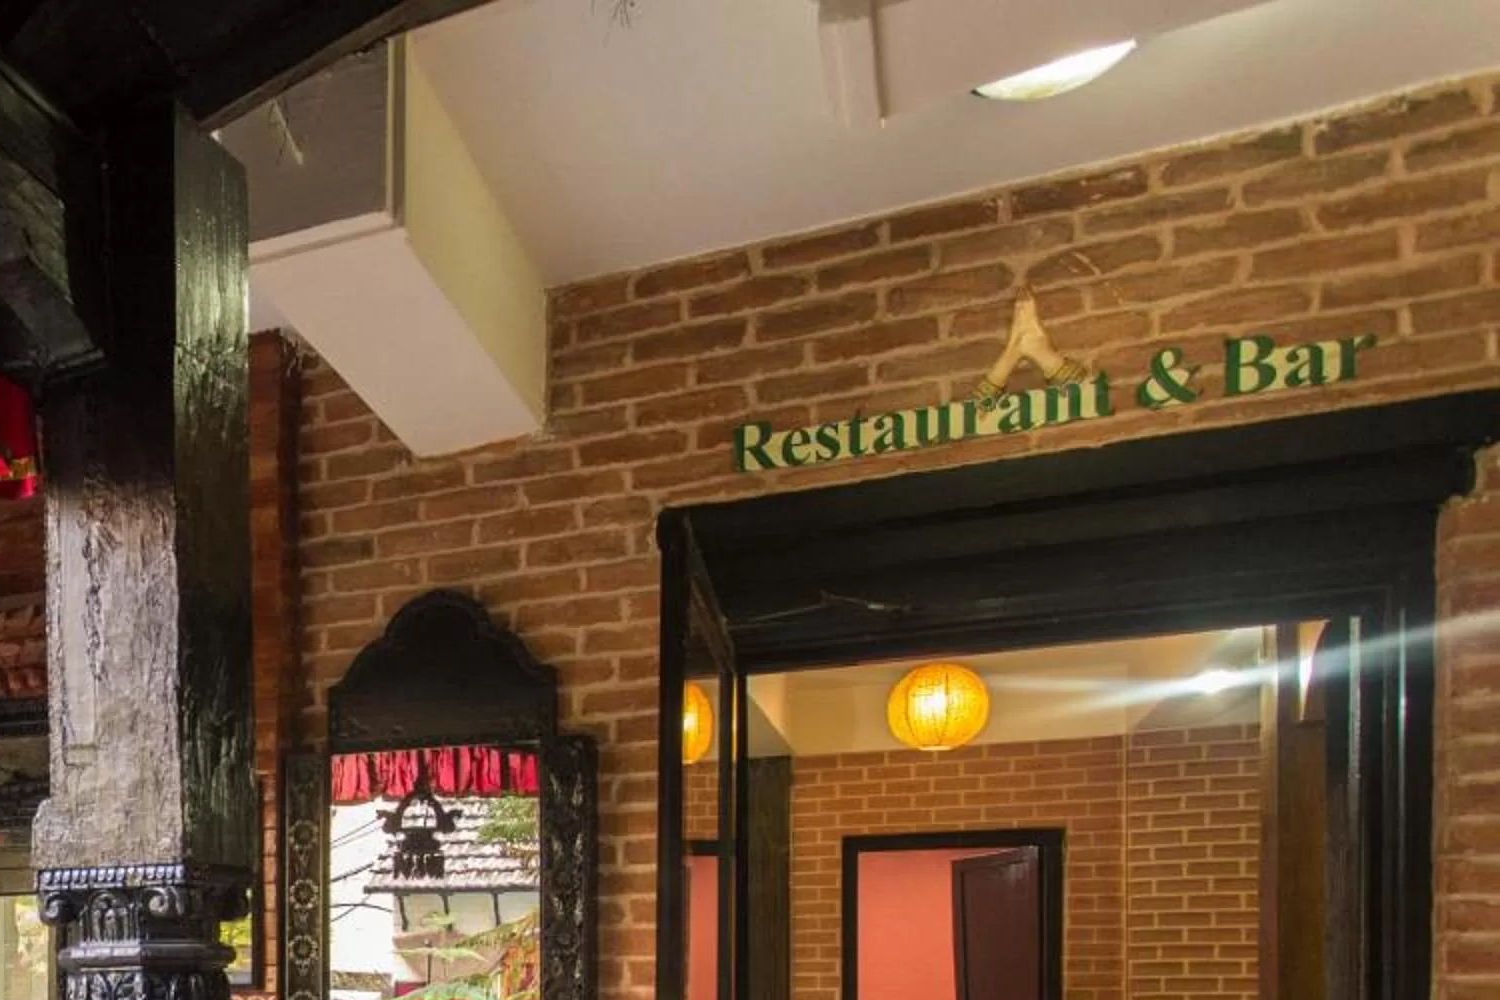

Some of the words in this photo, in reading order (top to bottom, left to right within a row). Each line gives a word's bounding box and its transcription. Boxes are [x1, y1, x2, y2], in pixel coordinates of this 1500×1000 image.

[733, 369, 1112, 472] Restaurant
[1137, 347, 1204, 410] &
[1223, 333, 1378, 397] Bar
